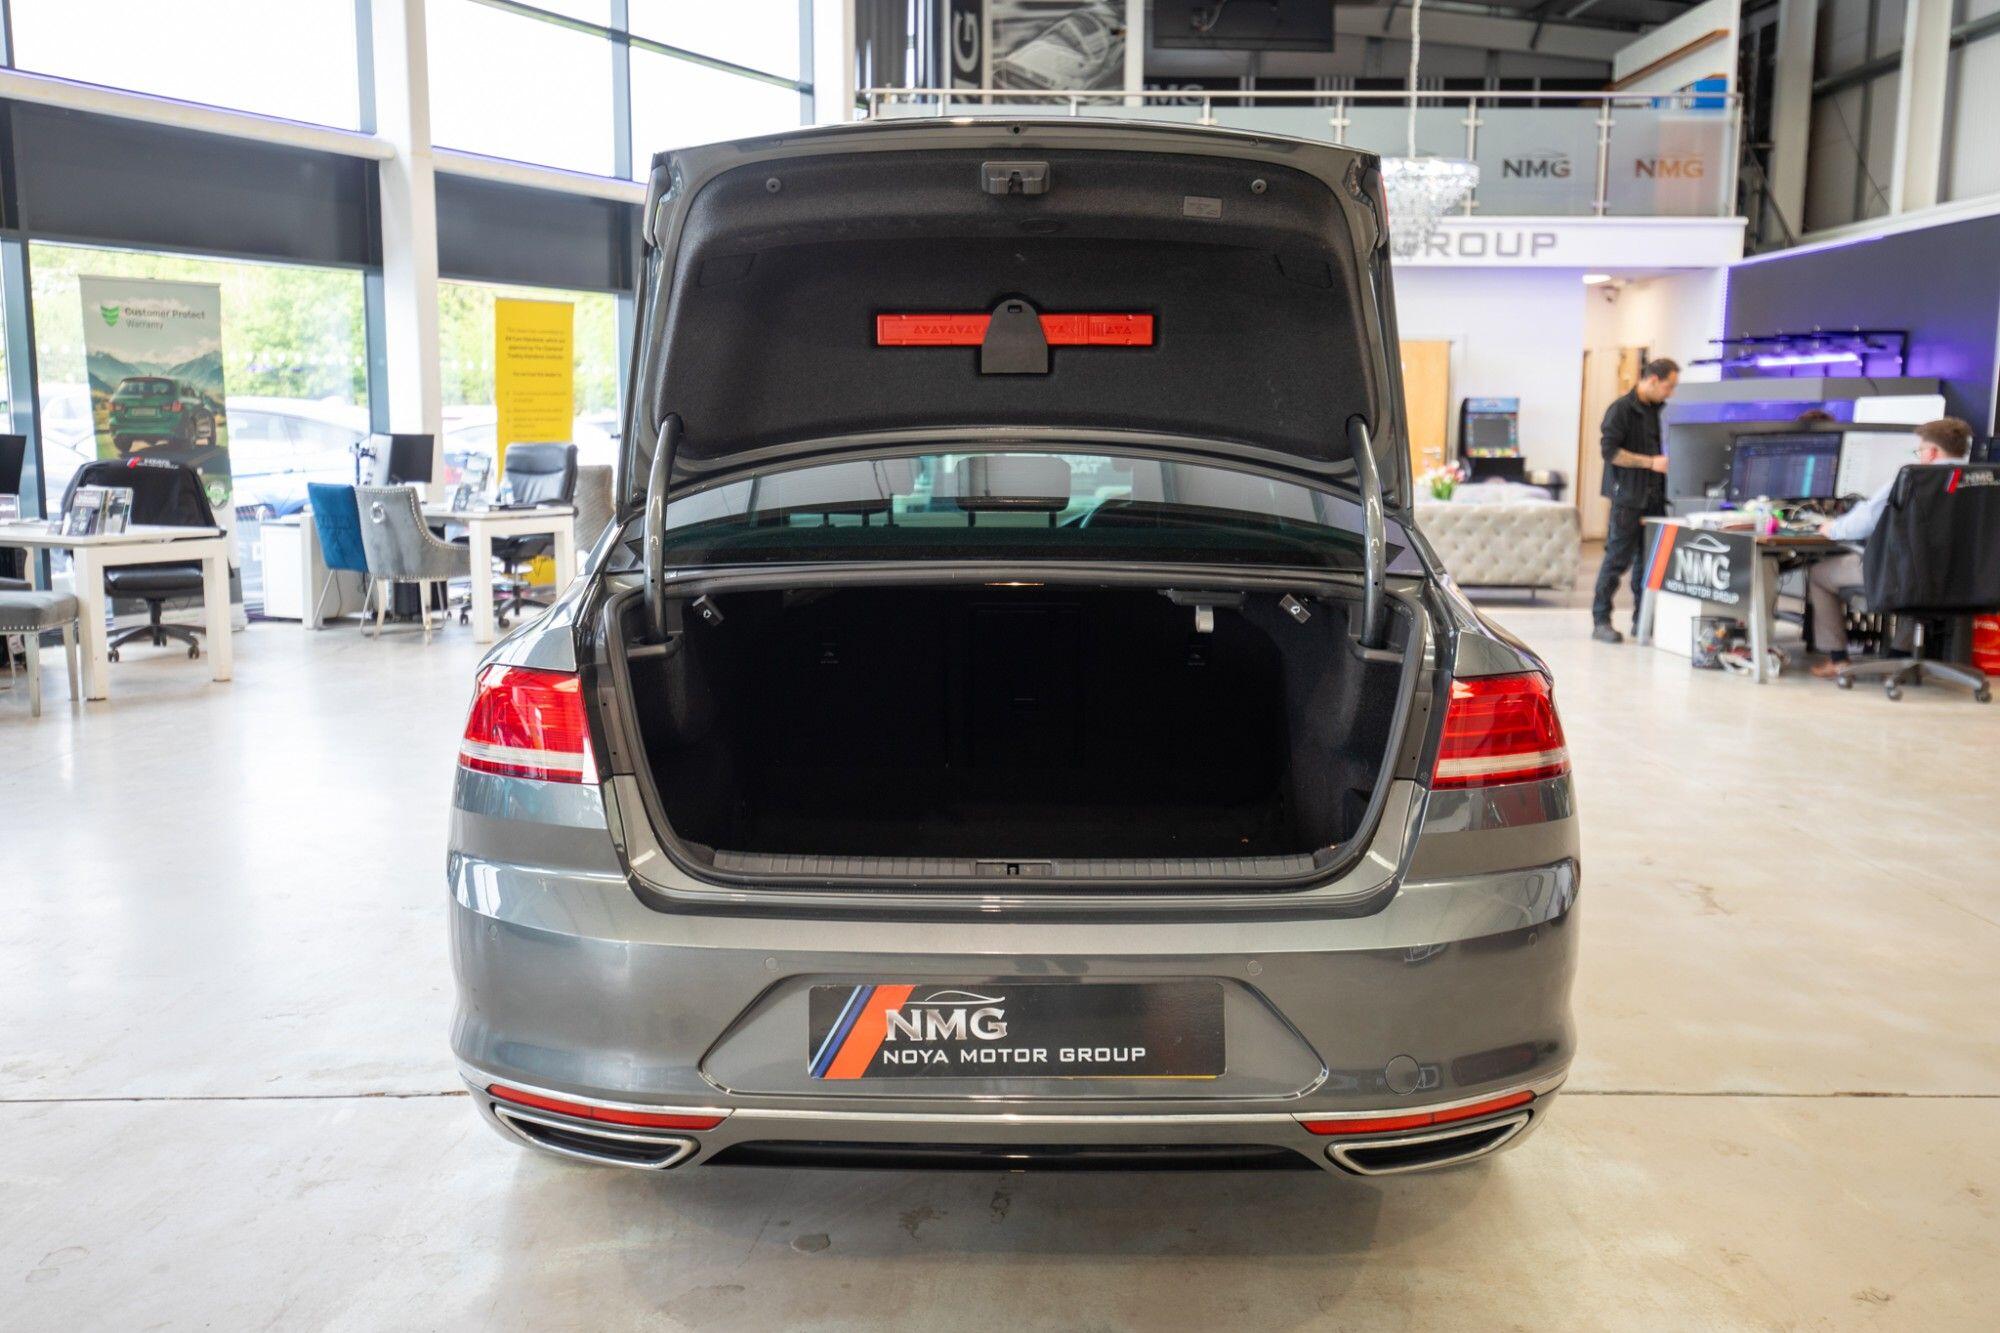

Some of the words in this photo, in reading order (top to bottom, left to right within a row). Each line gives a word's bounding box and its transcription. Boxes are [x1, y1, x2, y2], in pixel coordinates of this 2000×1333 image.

[1142, 83, 1205, 106] MG
[1502, 158, 1571, 179] NMG
[1635, 158, 1704, 179] NMG
[124, 307, 170, 318] Customer
[172, 310, 205, 320] Protect
[1674, 547, 1731, 591] NMG
[885, 1007, 1008, 1041] NMG
[884, 1049, 949, 1064] NOYA
[960, 1049, 1048, 1063] MOTOR
[1059, 1048, 1146, 1062] GROUP
